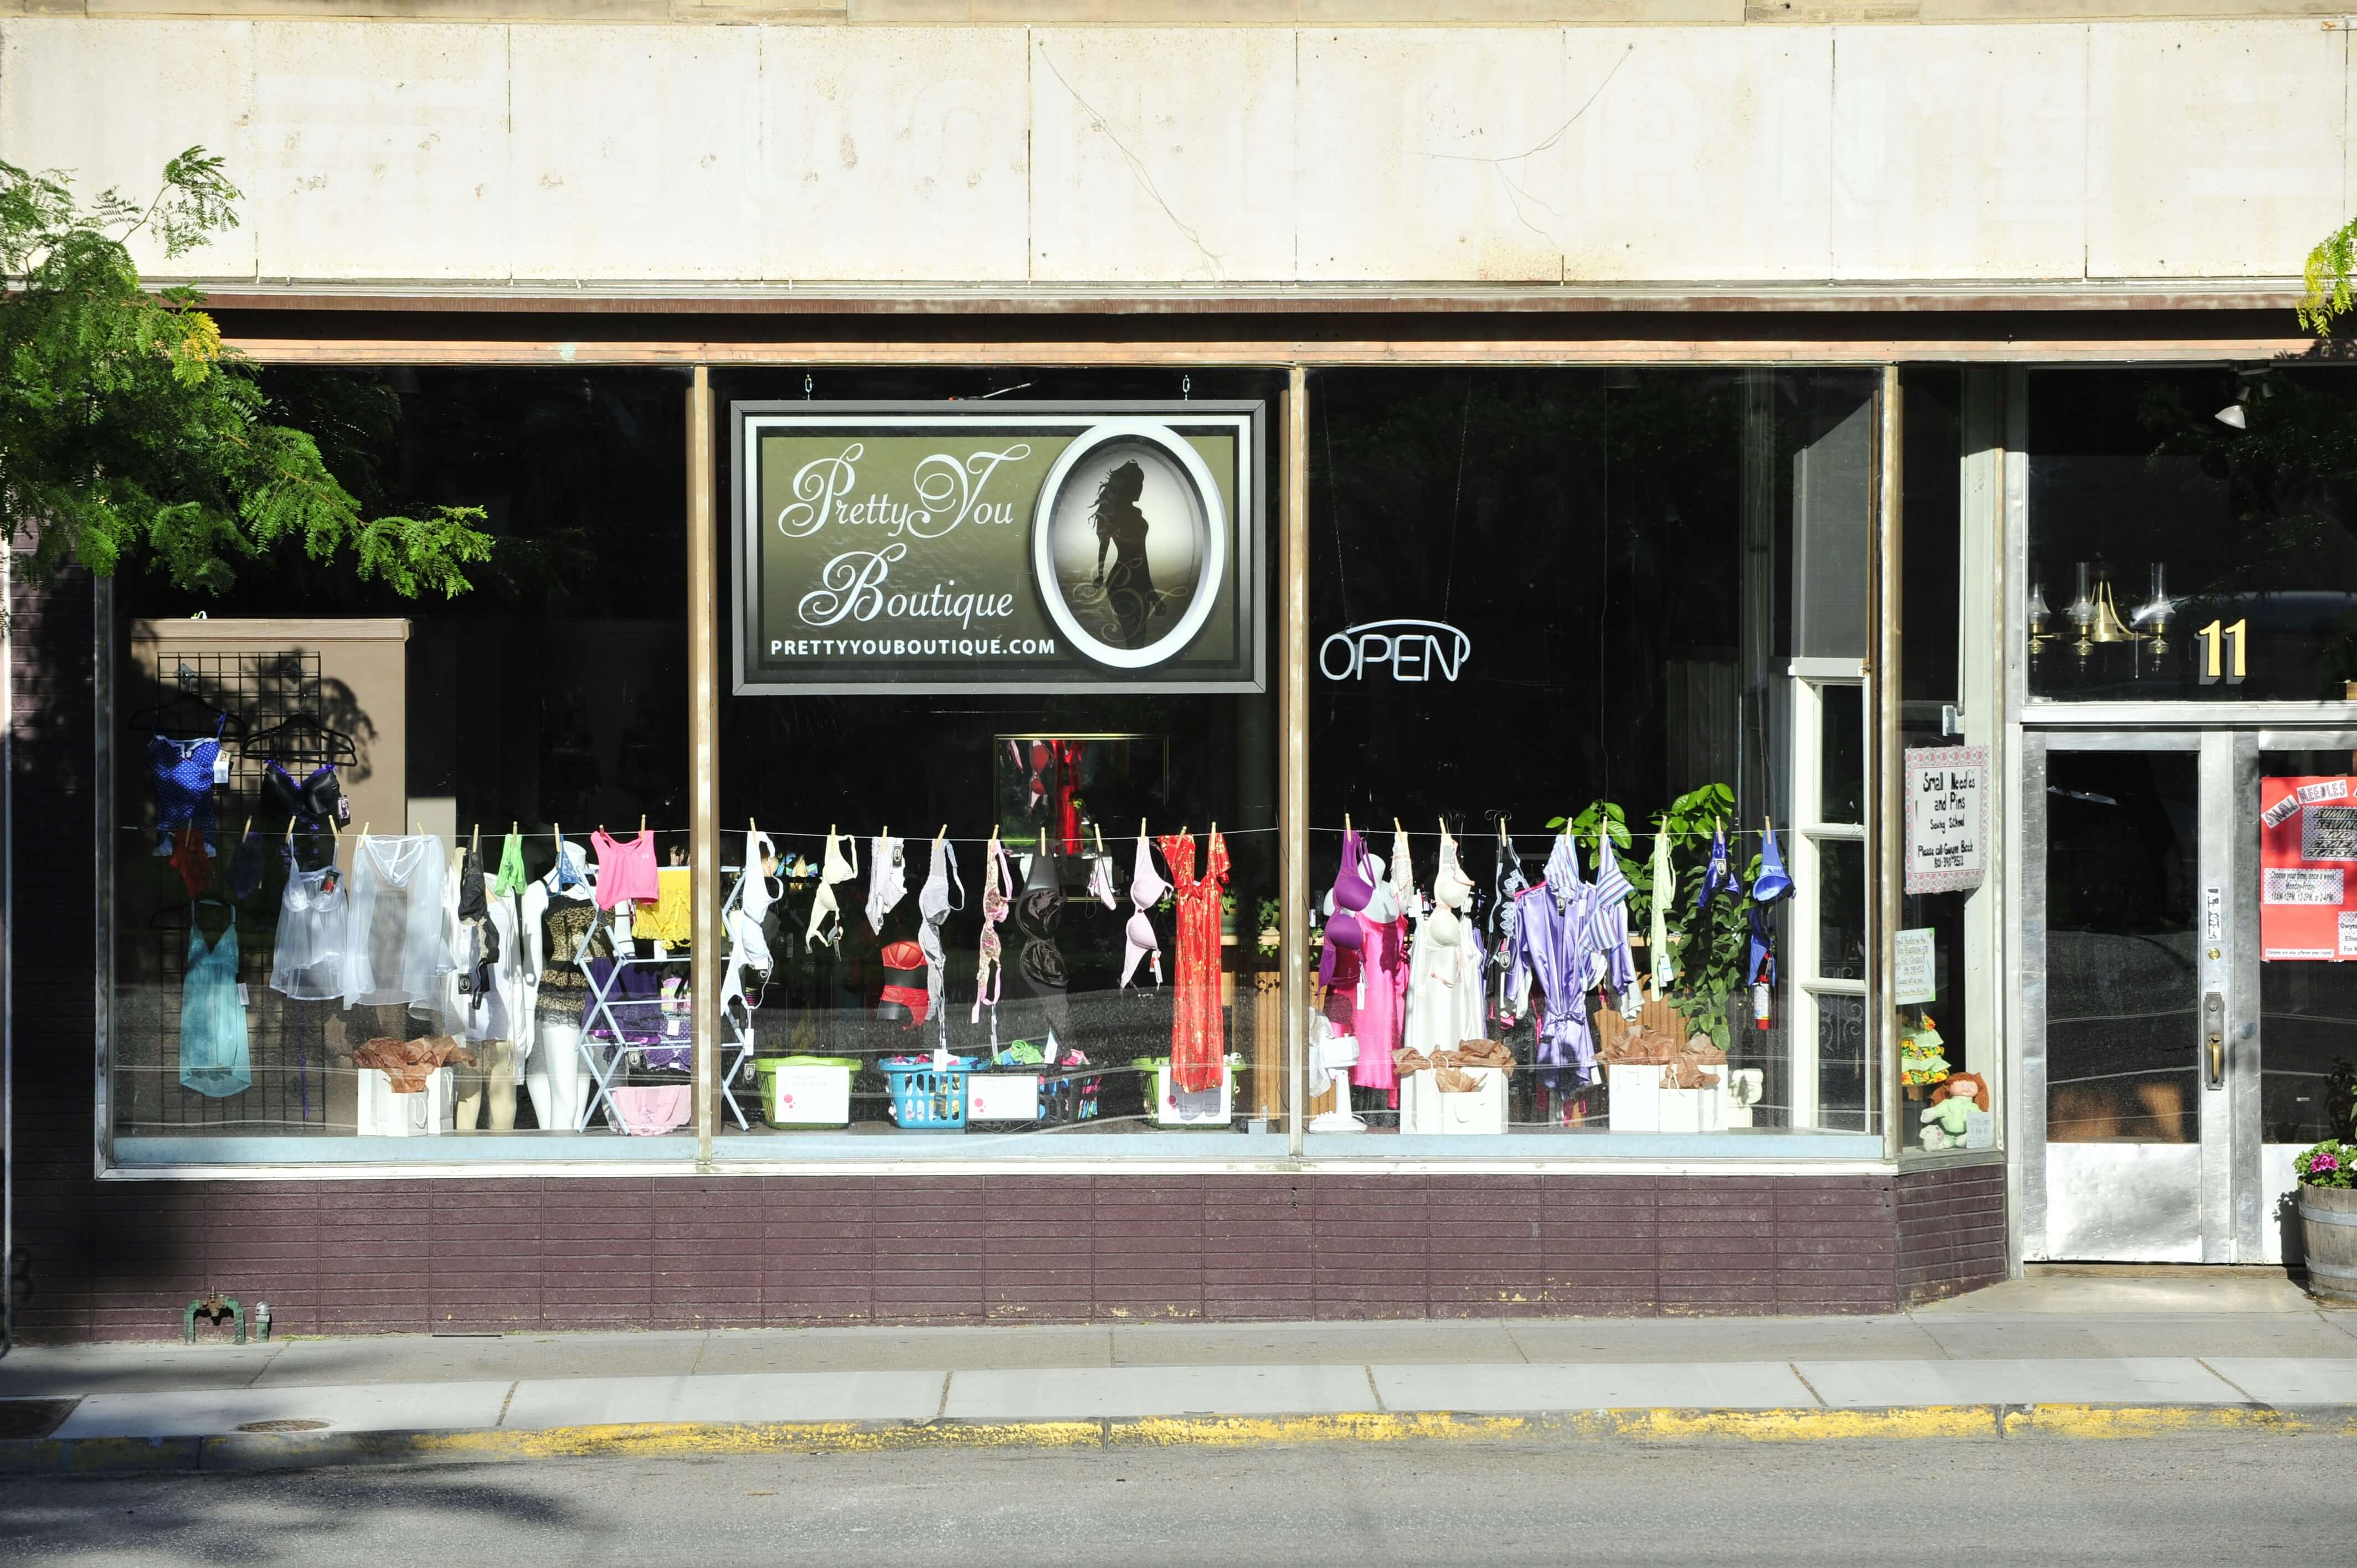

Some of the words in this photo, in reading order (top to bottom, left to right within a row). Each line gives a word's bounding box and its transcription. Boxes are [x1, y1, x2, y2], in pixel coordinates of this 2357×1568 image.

[778, 443, 910, 538] Pretty
[906, 443, 1031, 538] You
[798, 542, 1014, 630] Boutique
[771, 639, 1055, 658] PRETTYYOUBOUTIQUE.COM
[1320, 634, 1460, 682] OPEN
[2198, 618, 2246, 677] 11
[1923, 771, 1943, 792] Small
[1934, 792, 1947, 811] and
[1949, 791, 1965, 811] Pins
[2265, 798, 2299, 826] SMALL
[2298, 782, 2345, 803] NEEDLES
[1930, 818, 1946, 834] Sewing
[1949, 813, 1965, 829] School
[2319, 831, 2351, 839] AND
[1918, 845, 1934, 858] Please
[2304, 849, 2357, 857] CLASSE
[2271, 871, 2286, 879] Choose
